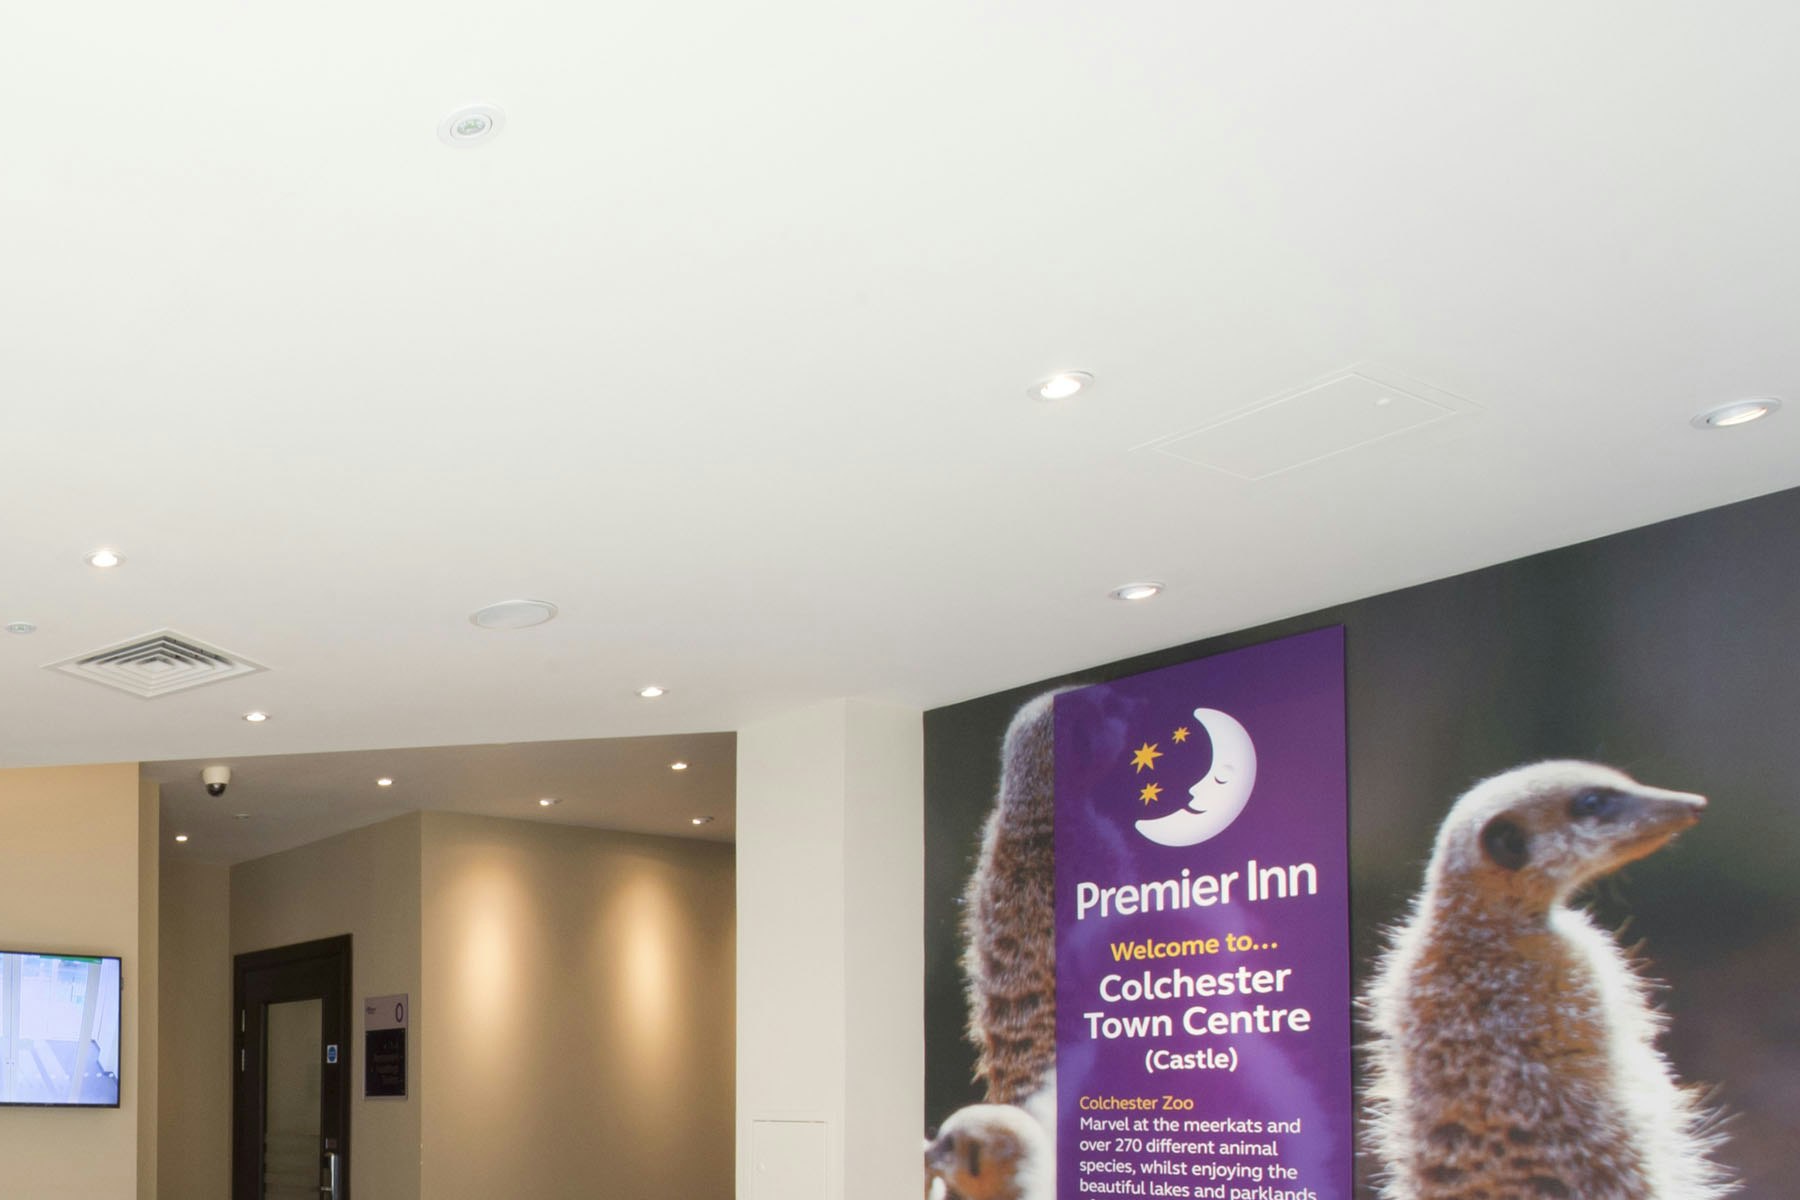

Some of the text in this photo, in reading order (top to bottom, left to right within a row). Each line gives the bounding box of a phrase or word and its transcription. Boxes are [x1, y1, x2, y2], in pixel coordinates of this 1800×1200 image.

[1077, 860, 1317, 920] Premier Inn
[1111, 937, 1220, 961] Welcome
[1099, 966, 1291, 1002] Colchester
[1083, 1005, 1311, 1039] Town Centre
[1145, 1047, 1238, 1073] (Castle)
[1080, 1096, 1194, 1110] Colchester Zoo
[1080, 1117, 1301, 1133] Marvel at the meerkats and
[1080, 1138, 1278, 1156] over 270 different animal
[1080, 1160, 1298, 1182] species, whilst enjoying the
[1080, 1179, 1146, 1195] beautiful
[1150, 1182, 1189, 1197] lakes
[1194, 1185, 1225, 1199] and
